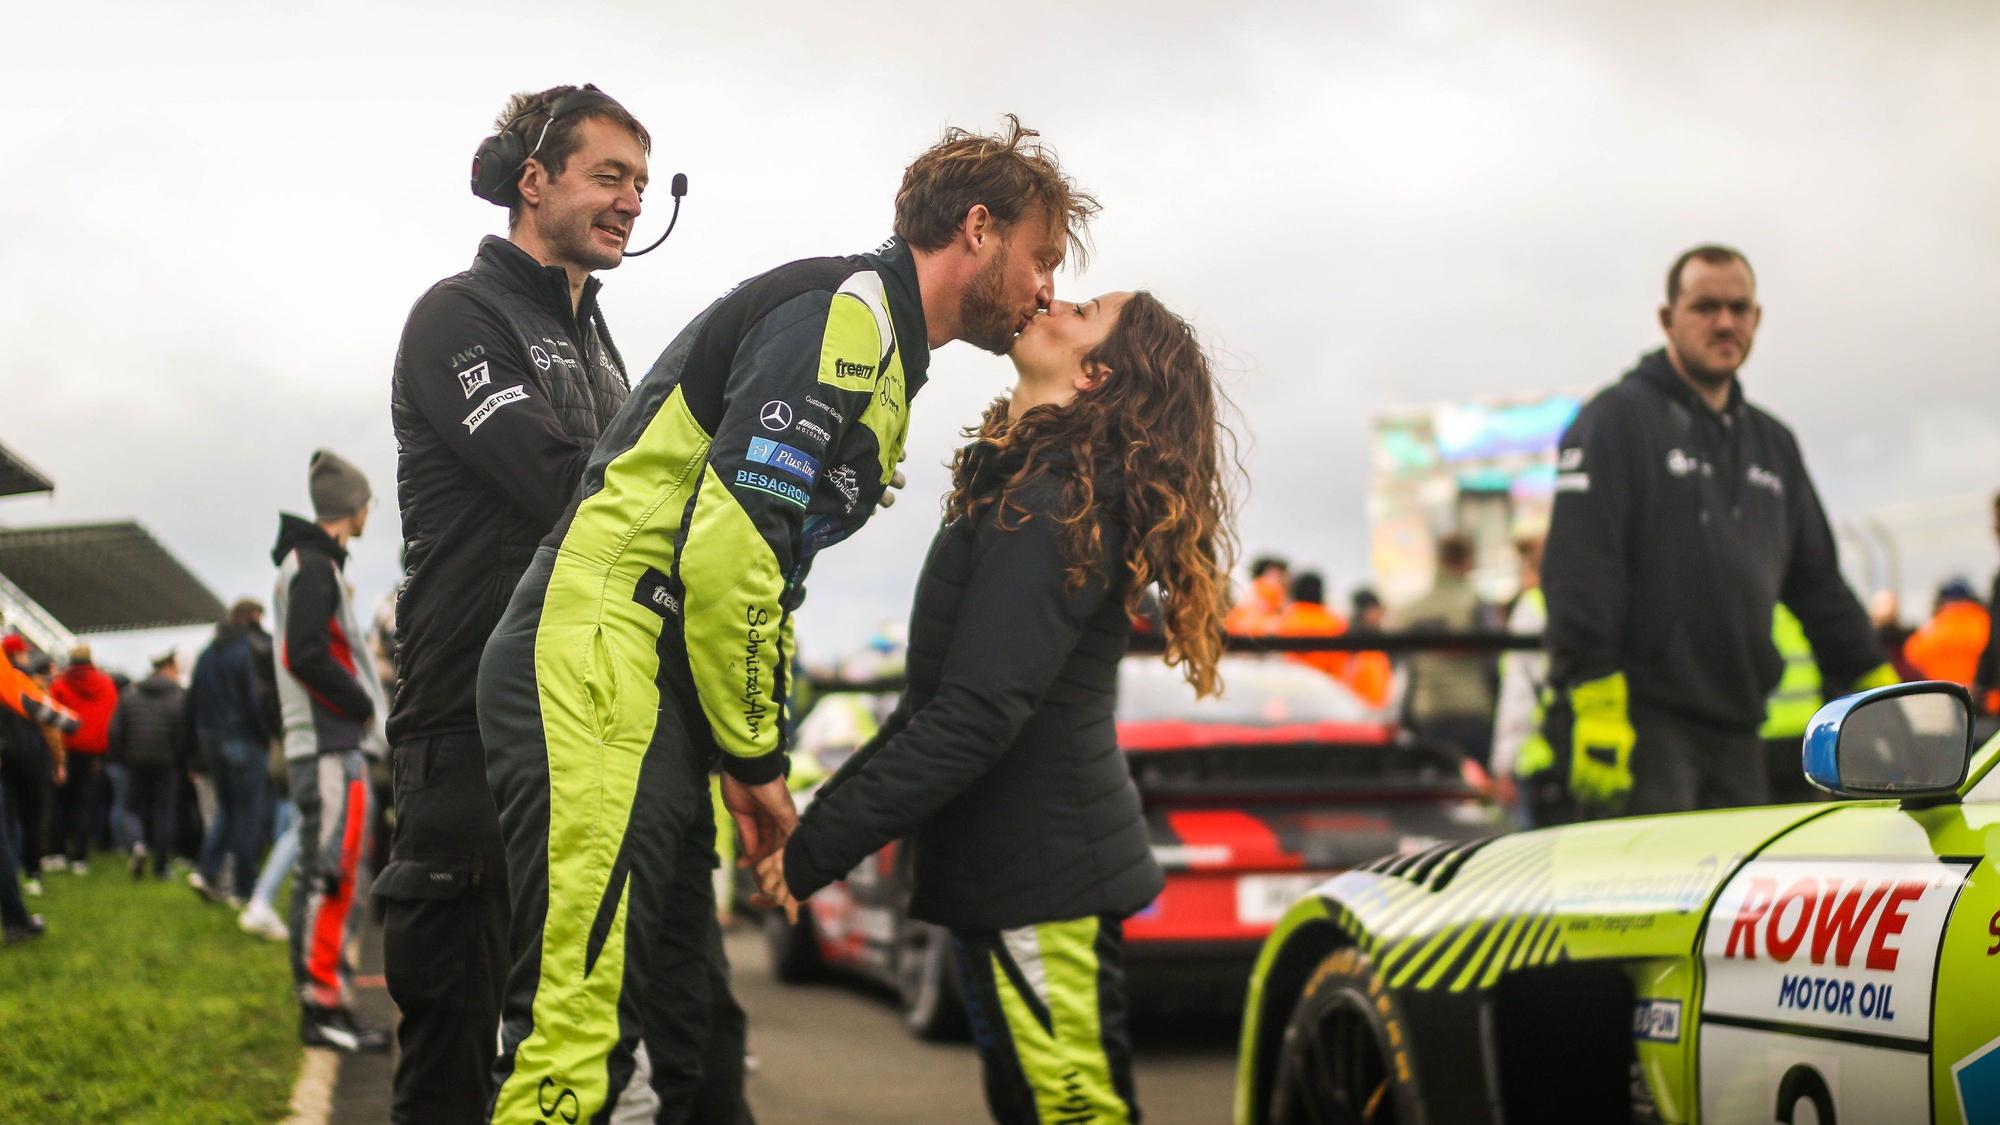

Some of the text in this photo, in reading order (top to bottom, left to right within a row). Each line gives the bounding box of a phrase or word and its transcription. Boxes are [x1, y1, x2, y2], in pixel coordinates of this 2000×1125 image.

[452, 345, 485, 368] JAKO
[834, 358, 876, 380] freem
[469, 389, 522, 426] RAVENOL
[805, 395, 830, 412] Customer
[775, 449, 816, 478] Plus.line
[1725, 876, 1926, 971] ROWE
[1777, 974, 1895, 1021] MOTOR OIL
